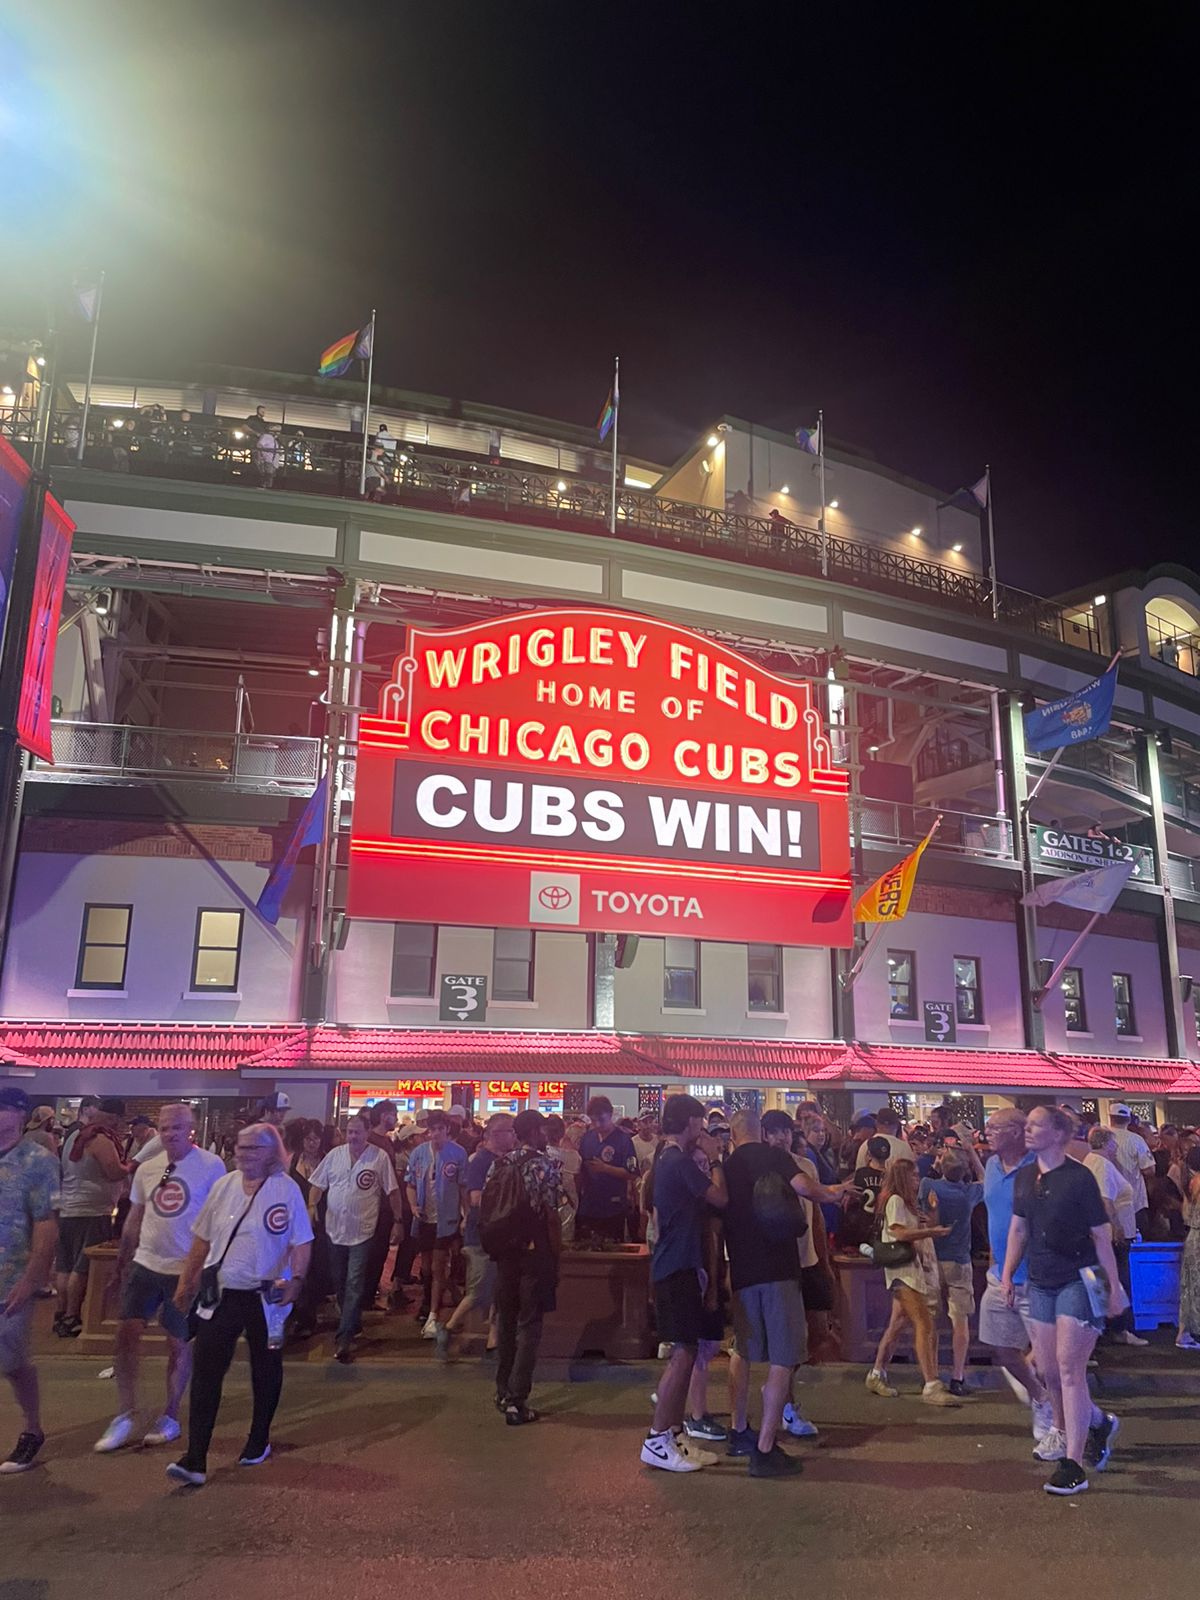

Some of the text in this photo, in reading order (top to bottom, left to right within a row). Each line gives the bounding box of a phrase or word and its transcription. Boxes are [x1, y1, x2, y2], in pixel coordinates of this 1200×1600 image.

[425, 627, 798, 731] WRIGLEY FIELD
[537, 680, 704, 721] HOME OF
[421, 710, 801, 787] CHICAGO CUBS
[415, 774, 802, 859] CUBS WIN!
[1043, 830, 1103, 855] GATES
[1044, 848, 1084, 862] ADDISON
[591, 890, 704, 920] TOYOTA
[444, 975, 485, 986] GATE
[448, 985, 478, 1012] 3
[925, 1002, 953, 1012] GATE
[930, 1011, 951, 1034] 3
